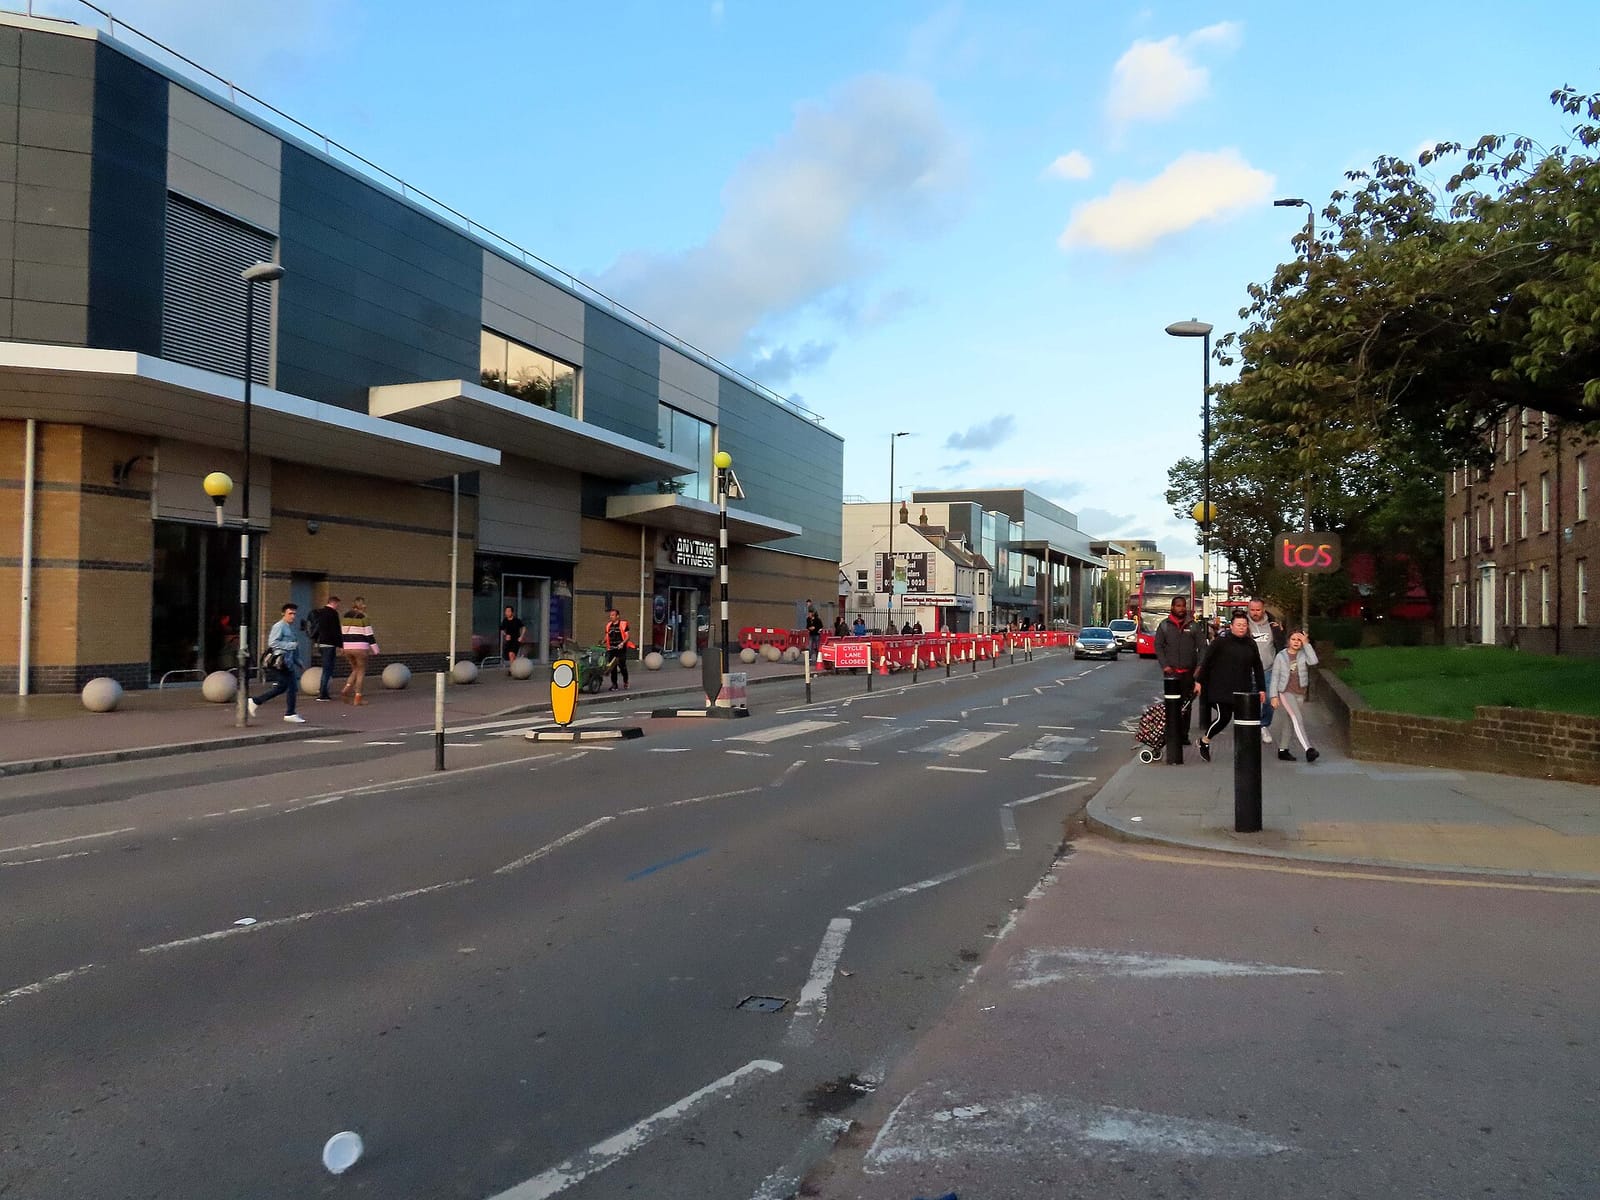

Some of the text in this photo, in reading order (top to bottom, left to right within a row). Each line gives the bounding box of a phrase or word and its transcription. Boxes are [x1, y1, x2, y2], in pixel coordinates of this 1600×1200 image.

[677, 537, 714, 556] ANYTIME
[1283, 538, 1333, 567] tcs
[677, 553, 714, 568] FITNESS
